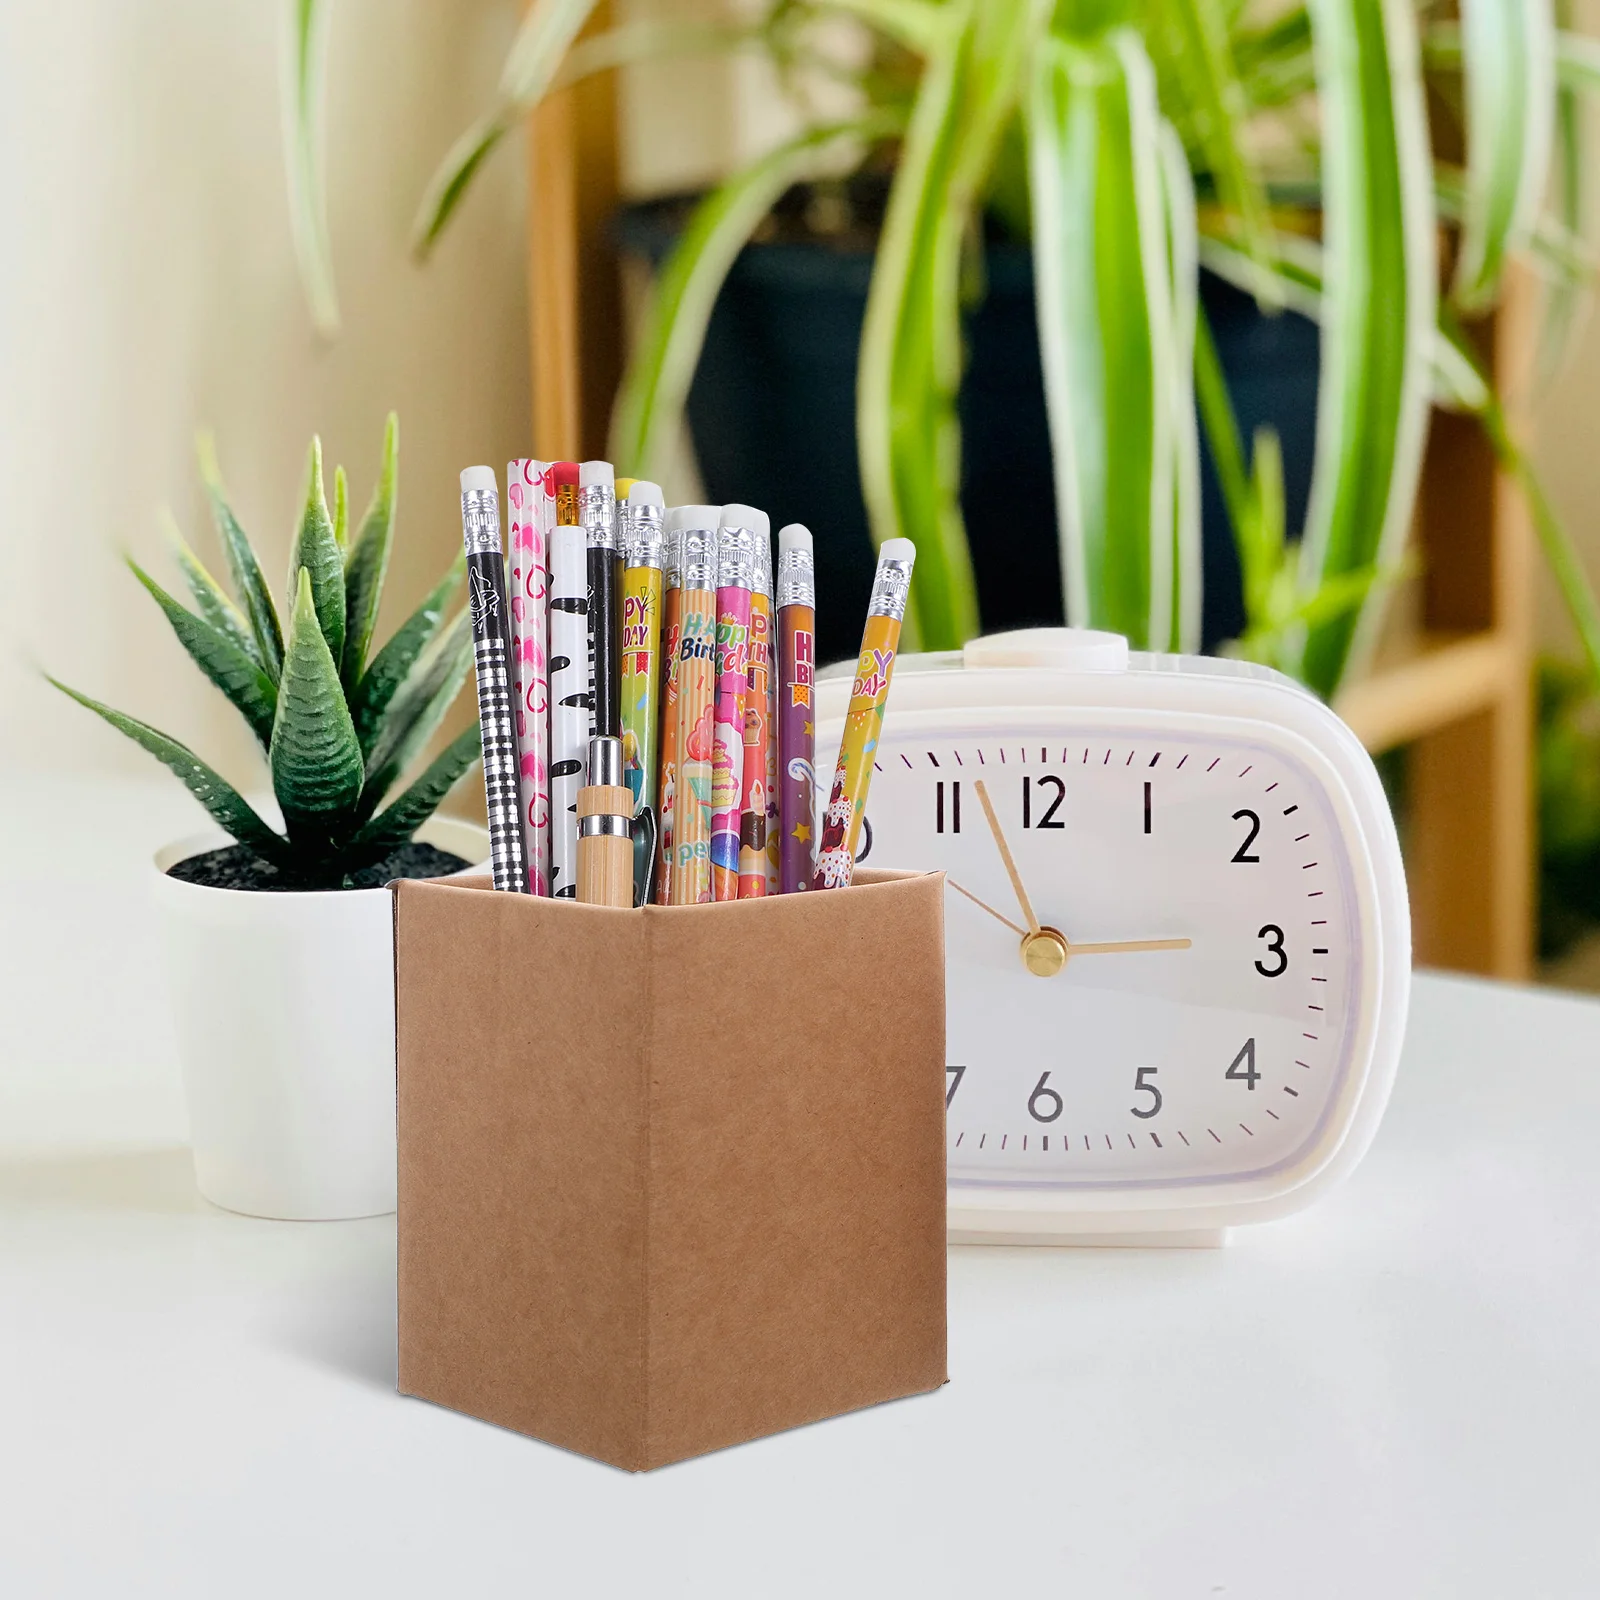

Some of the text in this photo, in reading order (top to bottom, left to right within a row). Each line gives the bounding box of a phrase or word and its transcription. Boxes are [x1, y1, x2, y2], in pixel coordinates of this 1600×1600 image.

[796, 631, 812, 662] H
[852, 673, 887, 696] DAY
[937, 782, 961, 834] 11
[1023, 775, 1066, 829] 12
[1144, 782, 1152, 835] 1
[1230, 809, 1261, 864] 2
[1254, 923, 1288, 978] 3
[1226, 1037, 1262, 1091] 4
[1028, 1071, 1064, 1124] 6
[1131, 1066, 1163, 1119] 5
